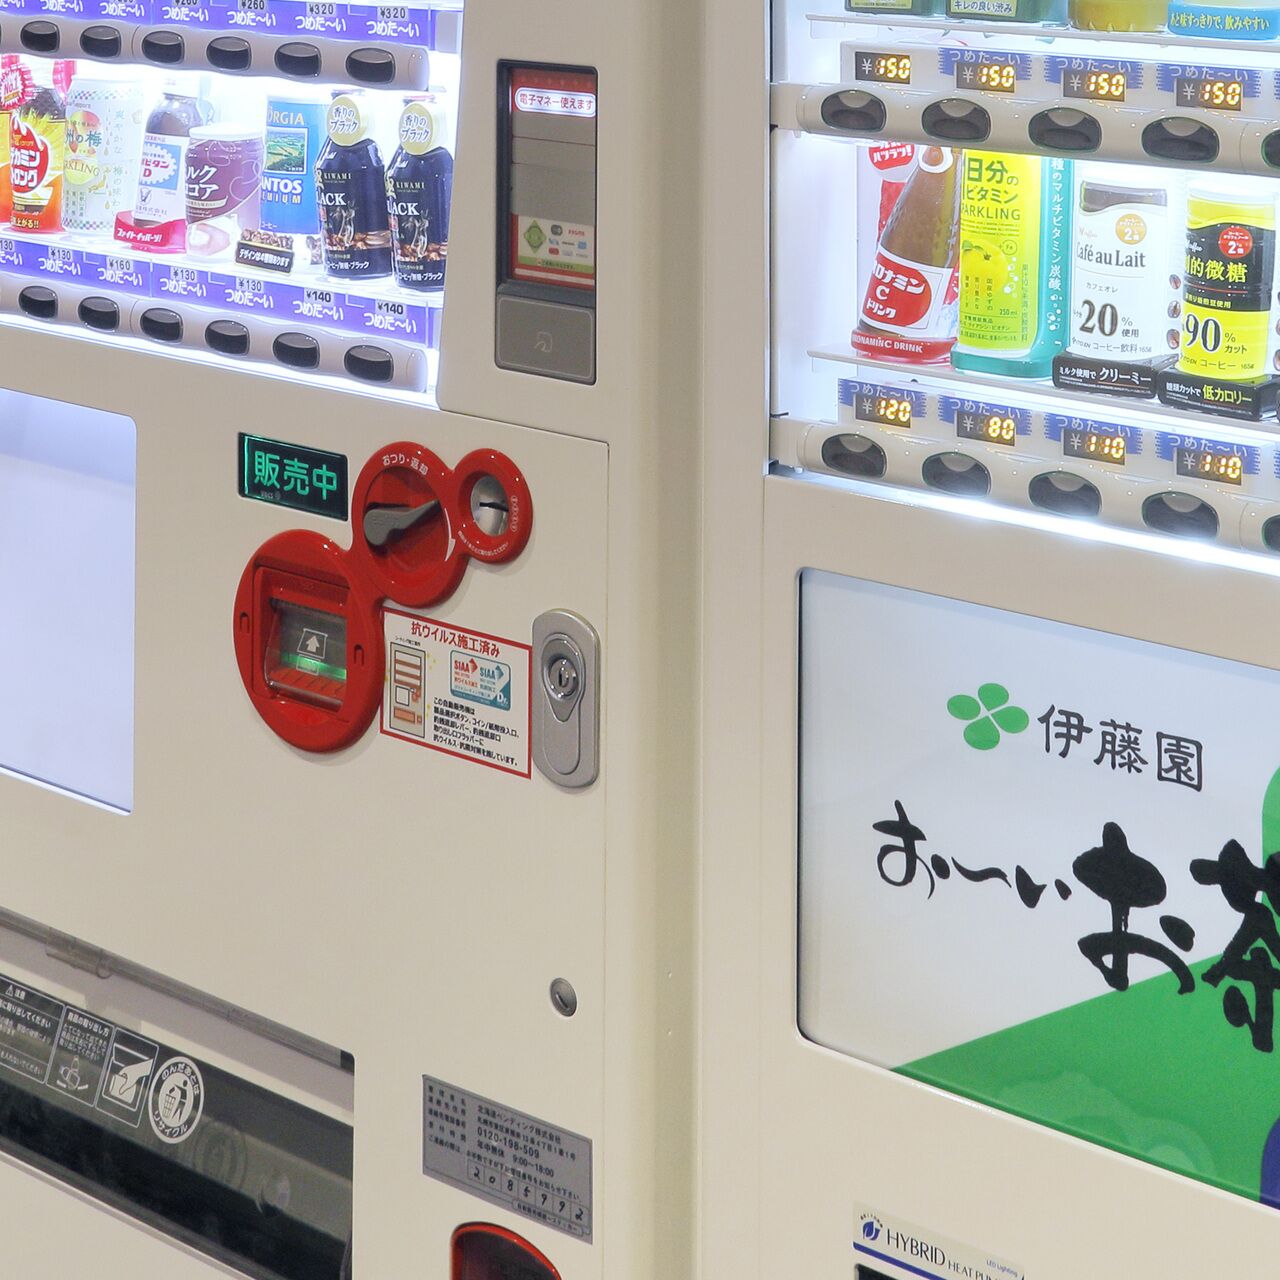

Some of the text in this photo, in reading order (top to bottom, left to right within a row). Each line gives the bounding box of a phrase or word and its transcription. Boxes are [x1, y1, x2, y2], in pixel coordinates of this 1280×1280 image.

[954, 0, 1013, 15] キレの良い渋み
[519, 91, 595, 113] 電子マネー使えます
[333, 106, 355, 120] 香りの
[404, 114, 426, 128] 香りの
[330, 119, 359, 132] ブラック
[400, 127, 430, 140] ブラック
[324, 172, 352, 181] KIWAMI
[396, 181, 425, 189] KIWAMI
[1095, 249, 1146, 268] au Lait
[1086, 282, 1118, 294] カフェオレ
[1080, 300, 1118, 336] 20
[894, 342, 923, 353] DRINK
[1224, 344, 1247, 355] カット
[254, 450, 338, 502] 販売中
[411, 620, 500, 658] 抗ウイルス施工済み
[1038, 703, 1203, 792] 伊藤園
[161, 1062, 200, 1096] のんだあとは
[152, 1110, 188, 1138] リサイクル
[477, 1127, 540, 1159] 0120-198-509
[887, 1228, 972, 1277] HYBRID HEAT
